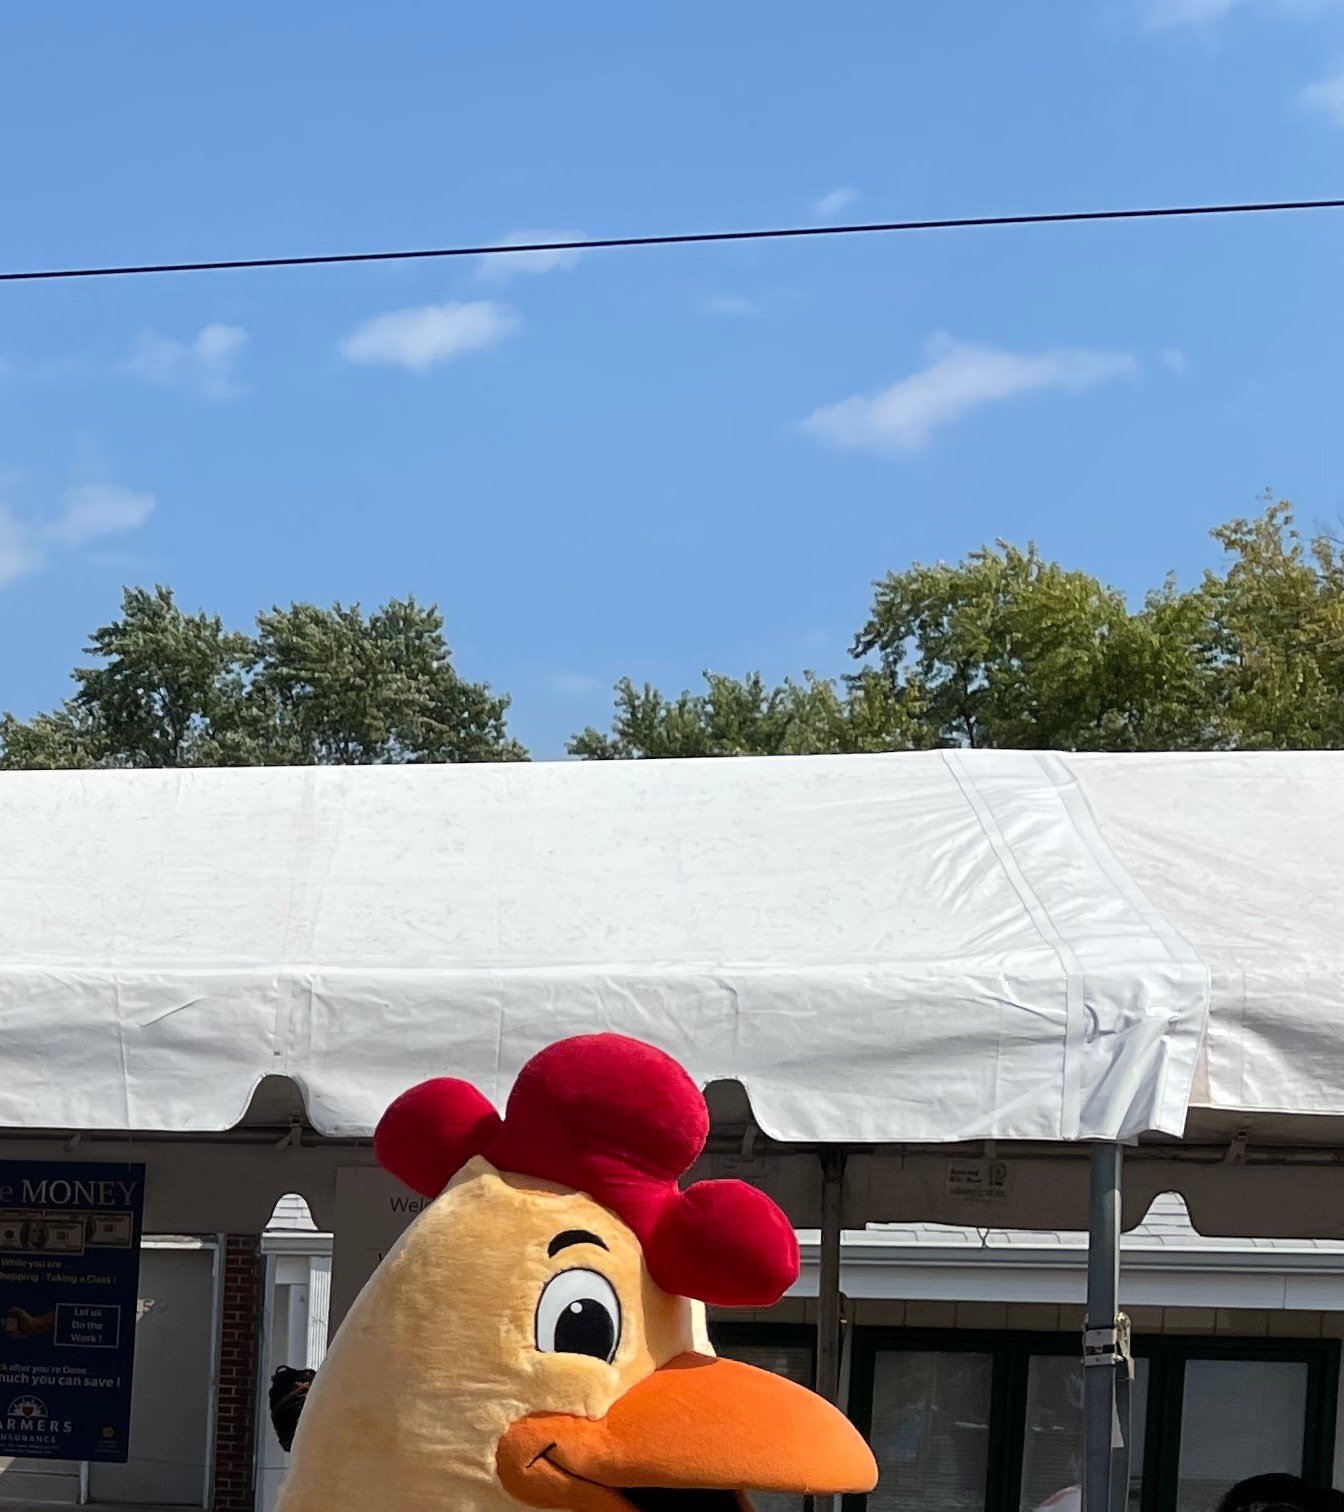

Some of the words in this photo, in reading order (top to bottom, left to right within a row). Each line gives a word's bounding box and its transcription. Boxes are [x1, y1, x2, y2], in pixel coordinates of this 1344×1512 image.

[21, 1179, 138, 1206] MONEY
[46, 1274, 78, 1284] Taking
[87, 1274, 111, 1284] Class
[31, 1375, 57, 1386] you
[59, 1376, 81, 1386] can
[84, 1378, 114, 1388] save
